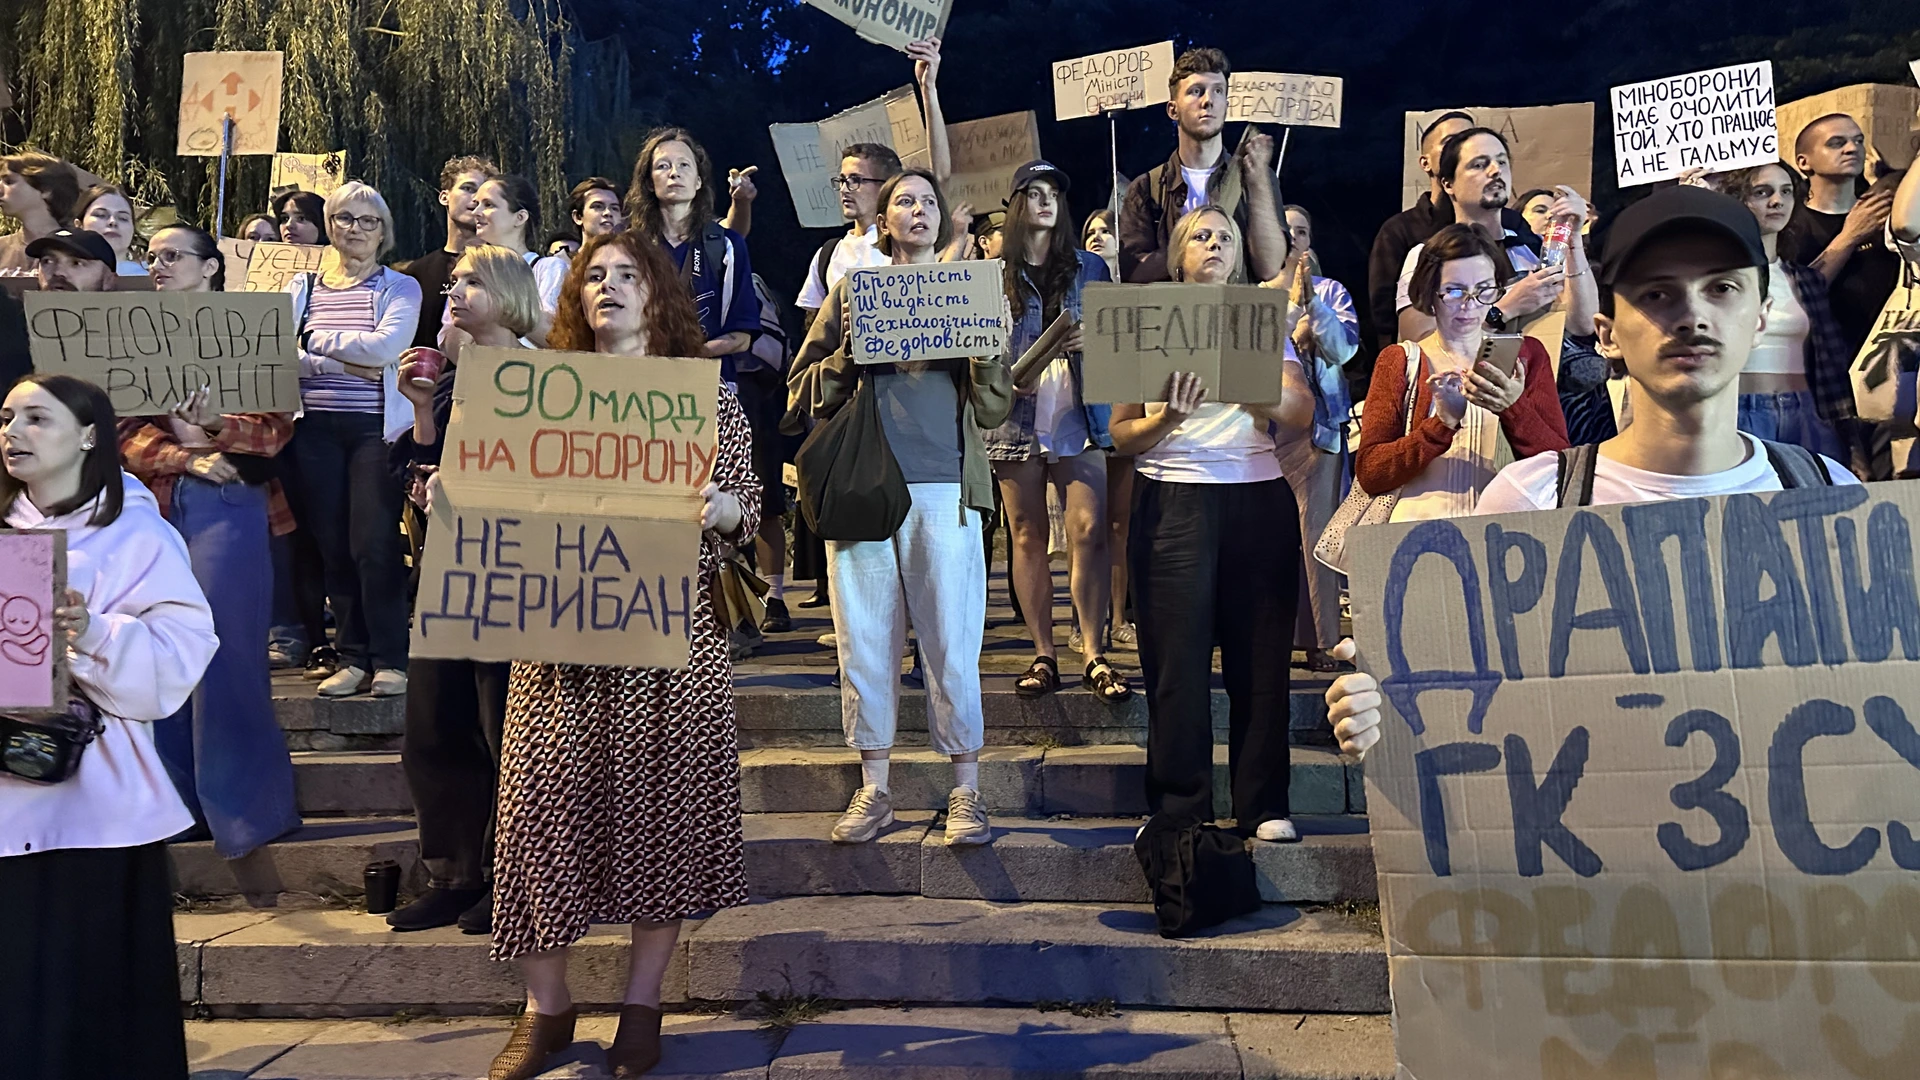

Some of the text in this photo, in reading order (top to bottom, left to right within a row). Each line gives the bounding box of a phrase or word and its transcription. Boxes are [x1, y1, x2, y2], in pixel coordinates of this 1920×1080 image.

[1056, 50, 1153, 84] ФЕДОРОВ
[1619, 67, 1761, 108] МІНОБОРОНИ
[1616, 126, 1660, 153] ТОЙ,
[1666, 119, 1703, 145] ХТО
[1711, 108, 1778, 136] ПРАЦЮЄ,
[1617, 106, 1660, 131] МАЄ
[1670, 87, 1773, 120] ОЧОЛИТИ
[1620, 135, 1776, 178] А НЕ ГАЛЬМУЄ
[852, 269, 972, 301] Прозорість
[855, 313, 1002, 338] Технологічність
[864, 328, 1000, 360] Федоровість
[459, 428, 719, 488] НА ОБОРОНУ
[455, 515, 631, 573] НЕ НА
[420, 570, 691, 641] ДЕРИБАН
[1415, 726, 1603, 877] ГК
